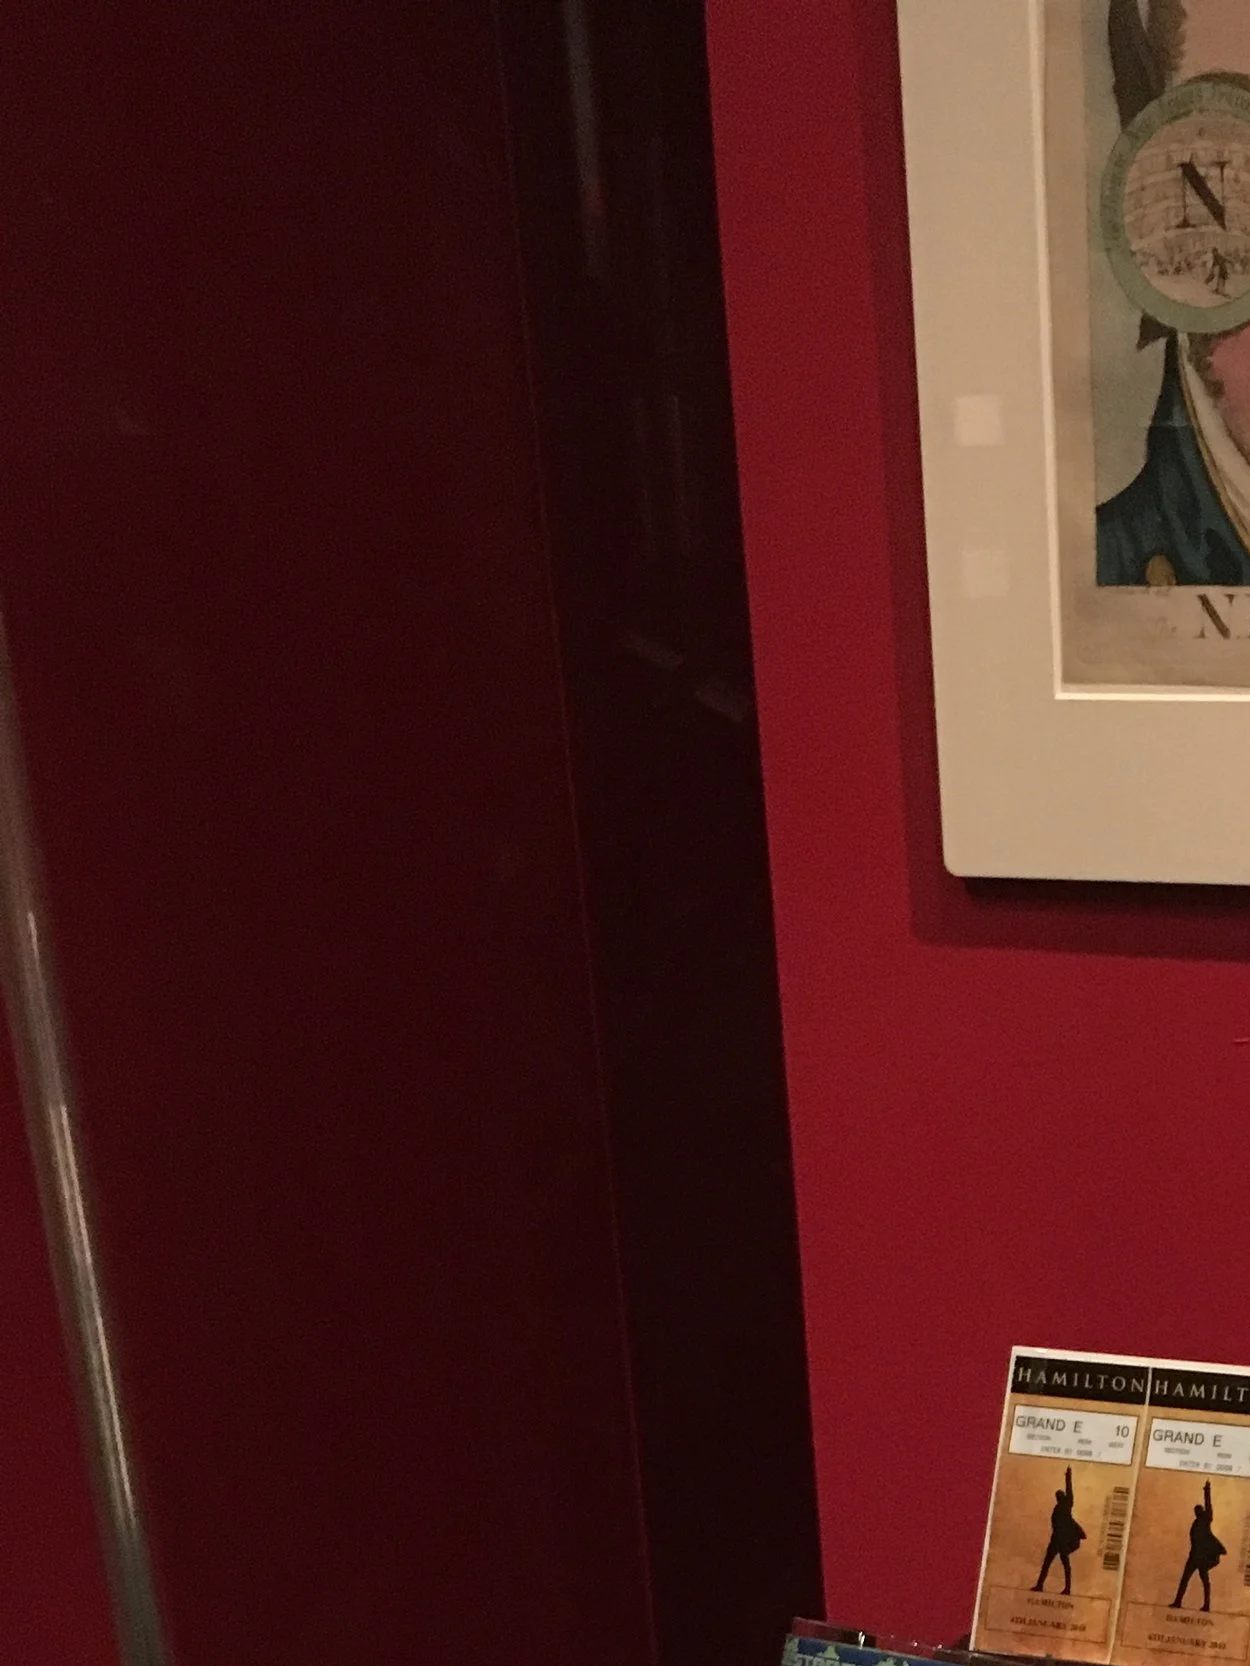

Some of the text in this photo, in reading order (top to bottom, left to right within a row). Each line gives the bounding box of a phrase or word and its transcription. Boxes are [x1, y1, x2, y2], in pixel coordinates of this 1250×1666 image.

[1174, 158, 1230, 233] N
[1016, 1367, 1145, 1393] HAMILTON
[1015, 1415, 1130, 1439] GRAND E 10
[1153, 1429, 1205, 1446] GRAND
[1213, 1434, 1222, 1448] E
